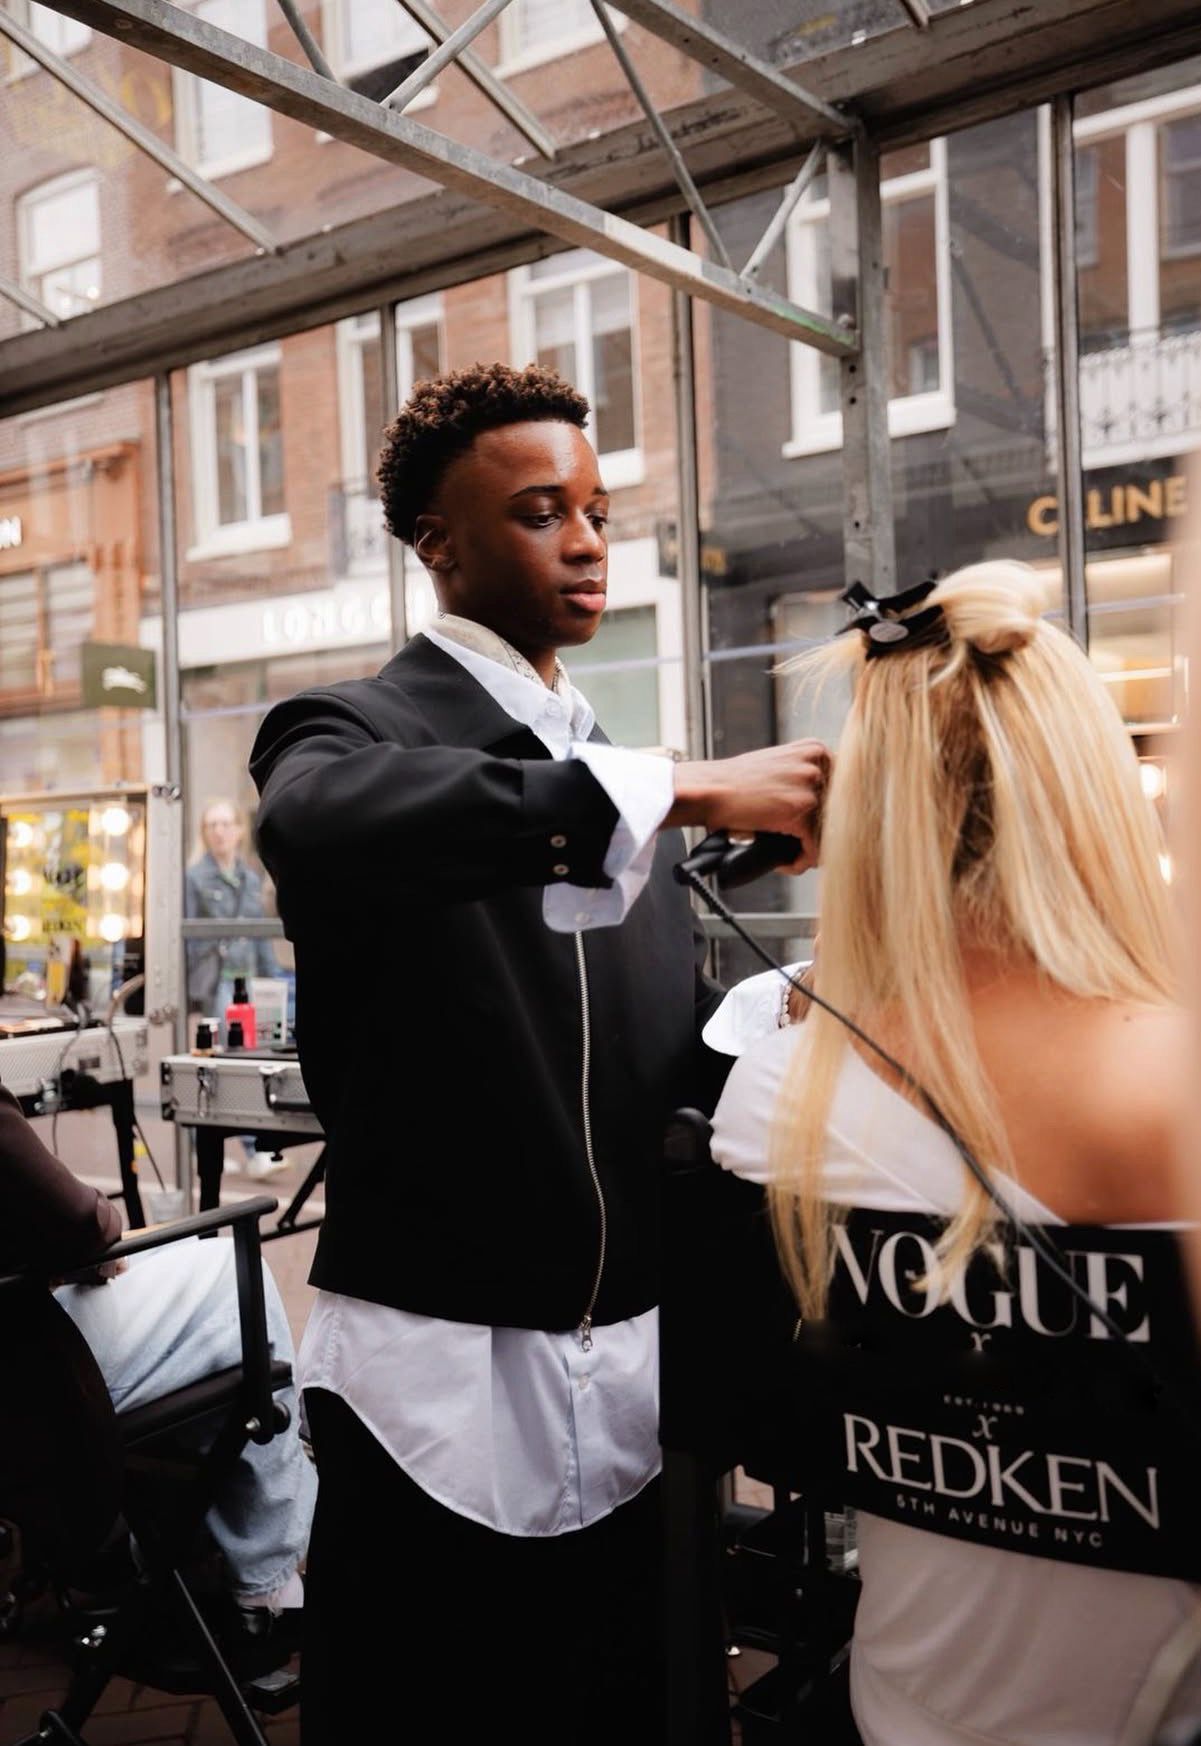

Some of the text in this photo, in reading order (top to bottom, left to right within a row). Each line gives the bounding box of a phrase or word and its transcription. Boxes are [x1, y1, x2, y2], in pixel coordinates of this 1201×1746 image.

[1027, 476, 1188, 536] CLINE
[832, 1224, 1150, 1343] VOGUE
[843, 1412, 1160, 1530] REDKEN
[897, 1494, 1103, 1548] 5TH AVENUE NYC
